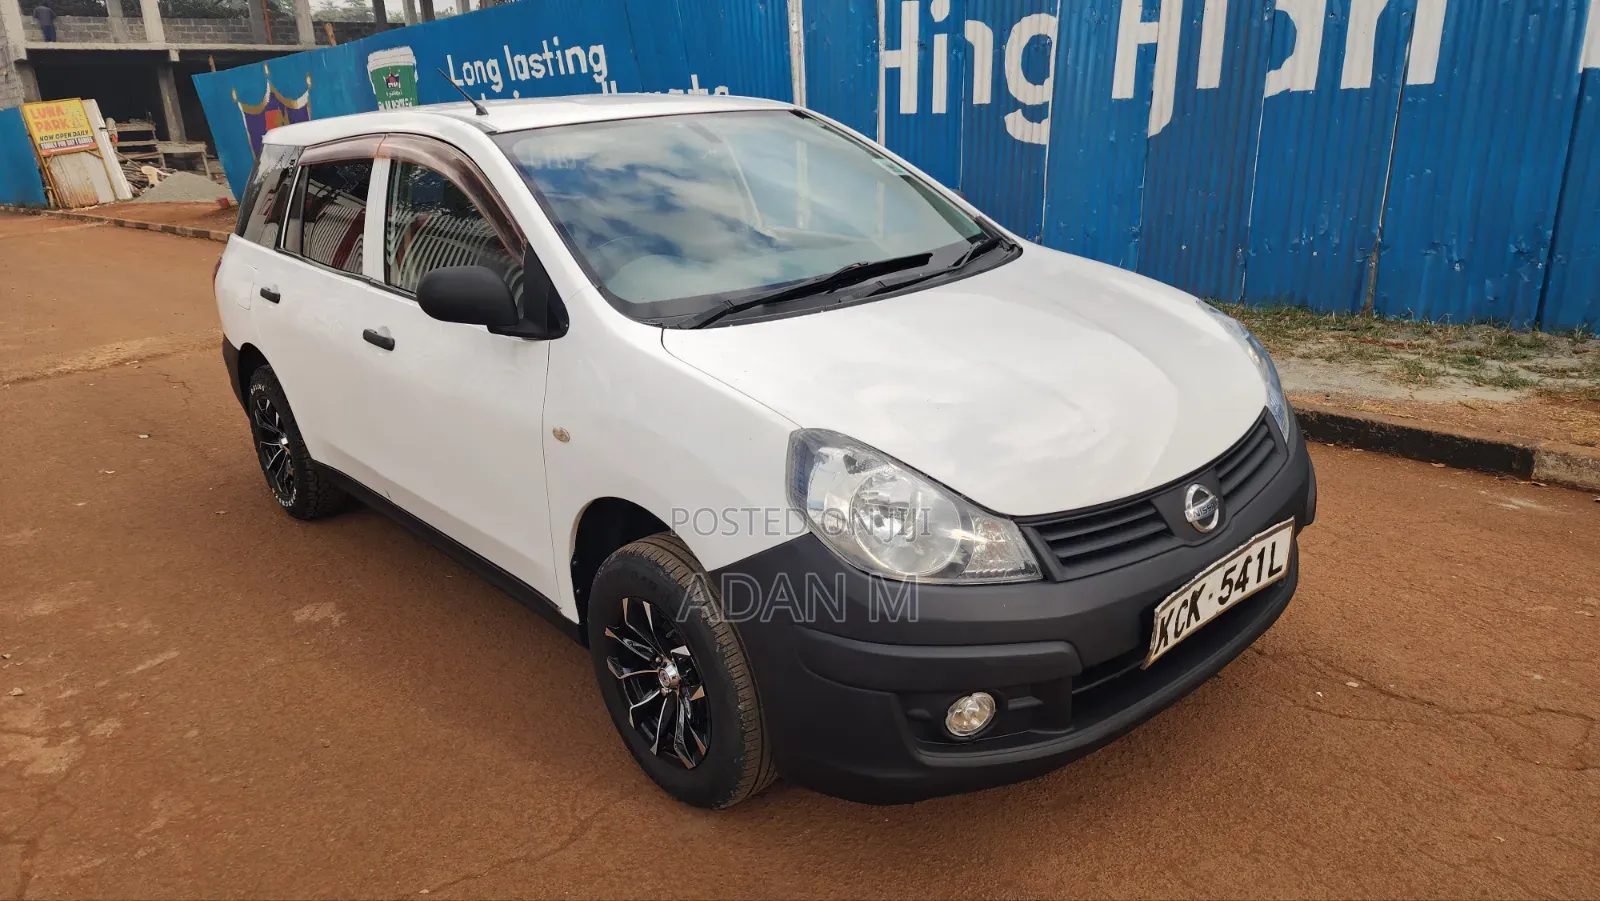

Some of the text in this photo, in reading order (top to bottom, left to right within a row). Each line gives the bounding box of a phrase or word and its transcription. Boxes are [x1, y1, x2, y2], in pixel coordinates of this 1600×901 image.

[446, 54, 504, 93] Long
[503, 36, 608, 83] lasting
[34, 118, 70, 133] PARK
[40, 134, 55, 142] NOW
[55, 132, 72, 140] OPEN
